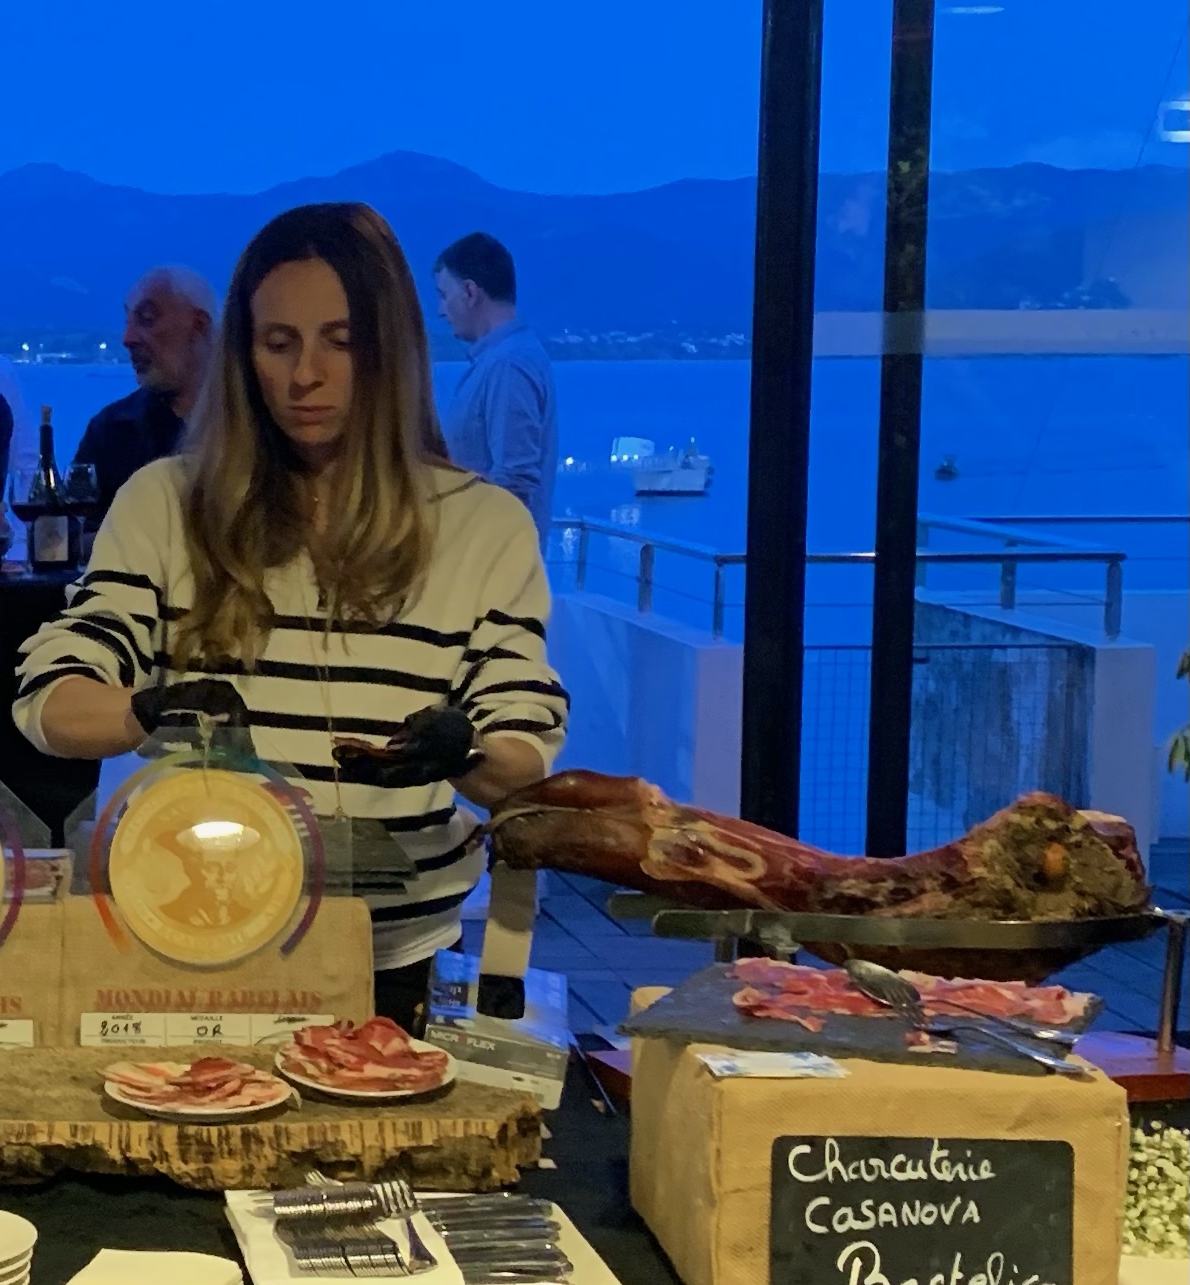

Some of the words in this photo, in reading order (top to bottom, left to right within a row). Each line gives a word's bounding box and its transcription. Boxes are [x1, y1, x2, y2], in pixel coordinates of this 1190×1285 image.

[94, 988, 197, 1009] MONDIAL
[208, 988, 323, 1010] RABELAIS
[196, 1023, 223, 1038] OR
[788, 1138, 997, 1184] Charcuterie
